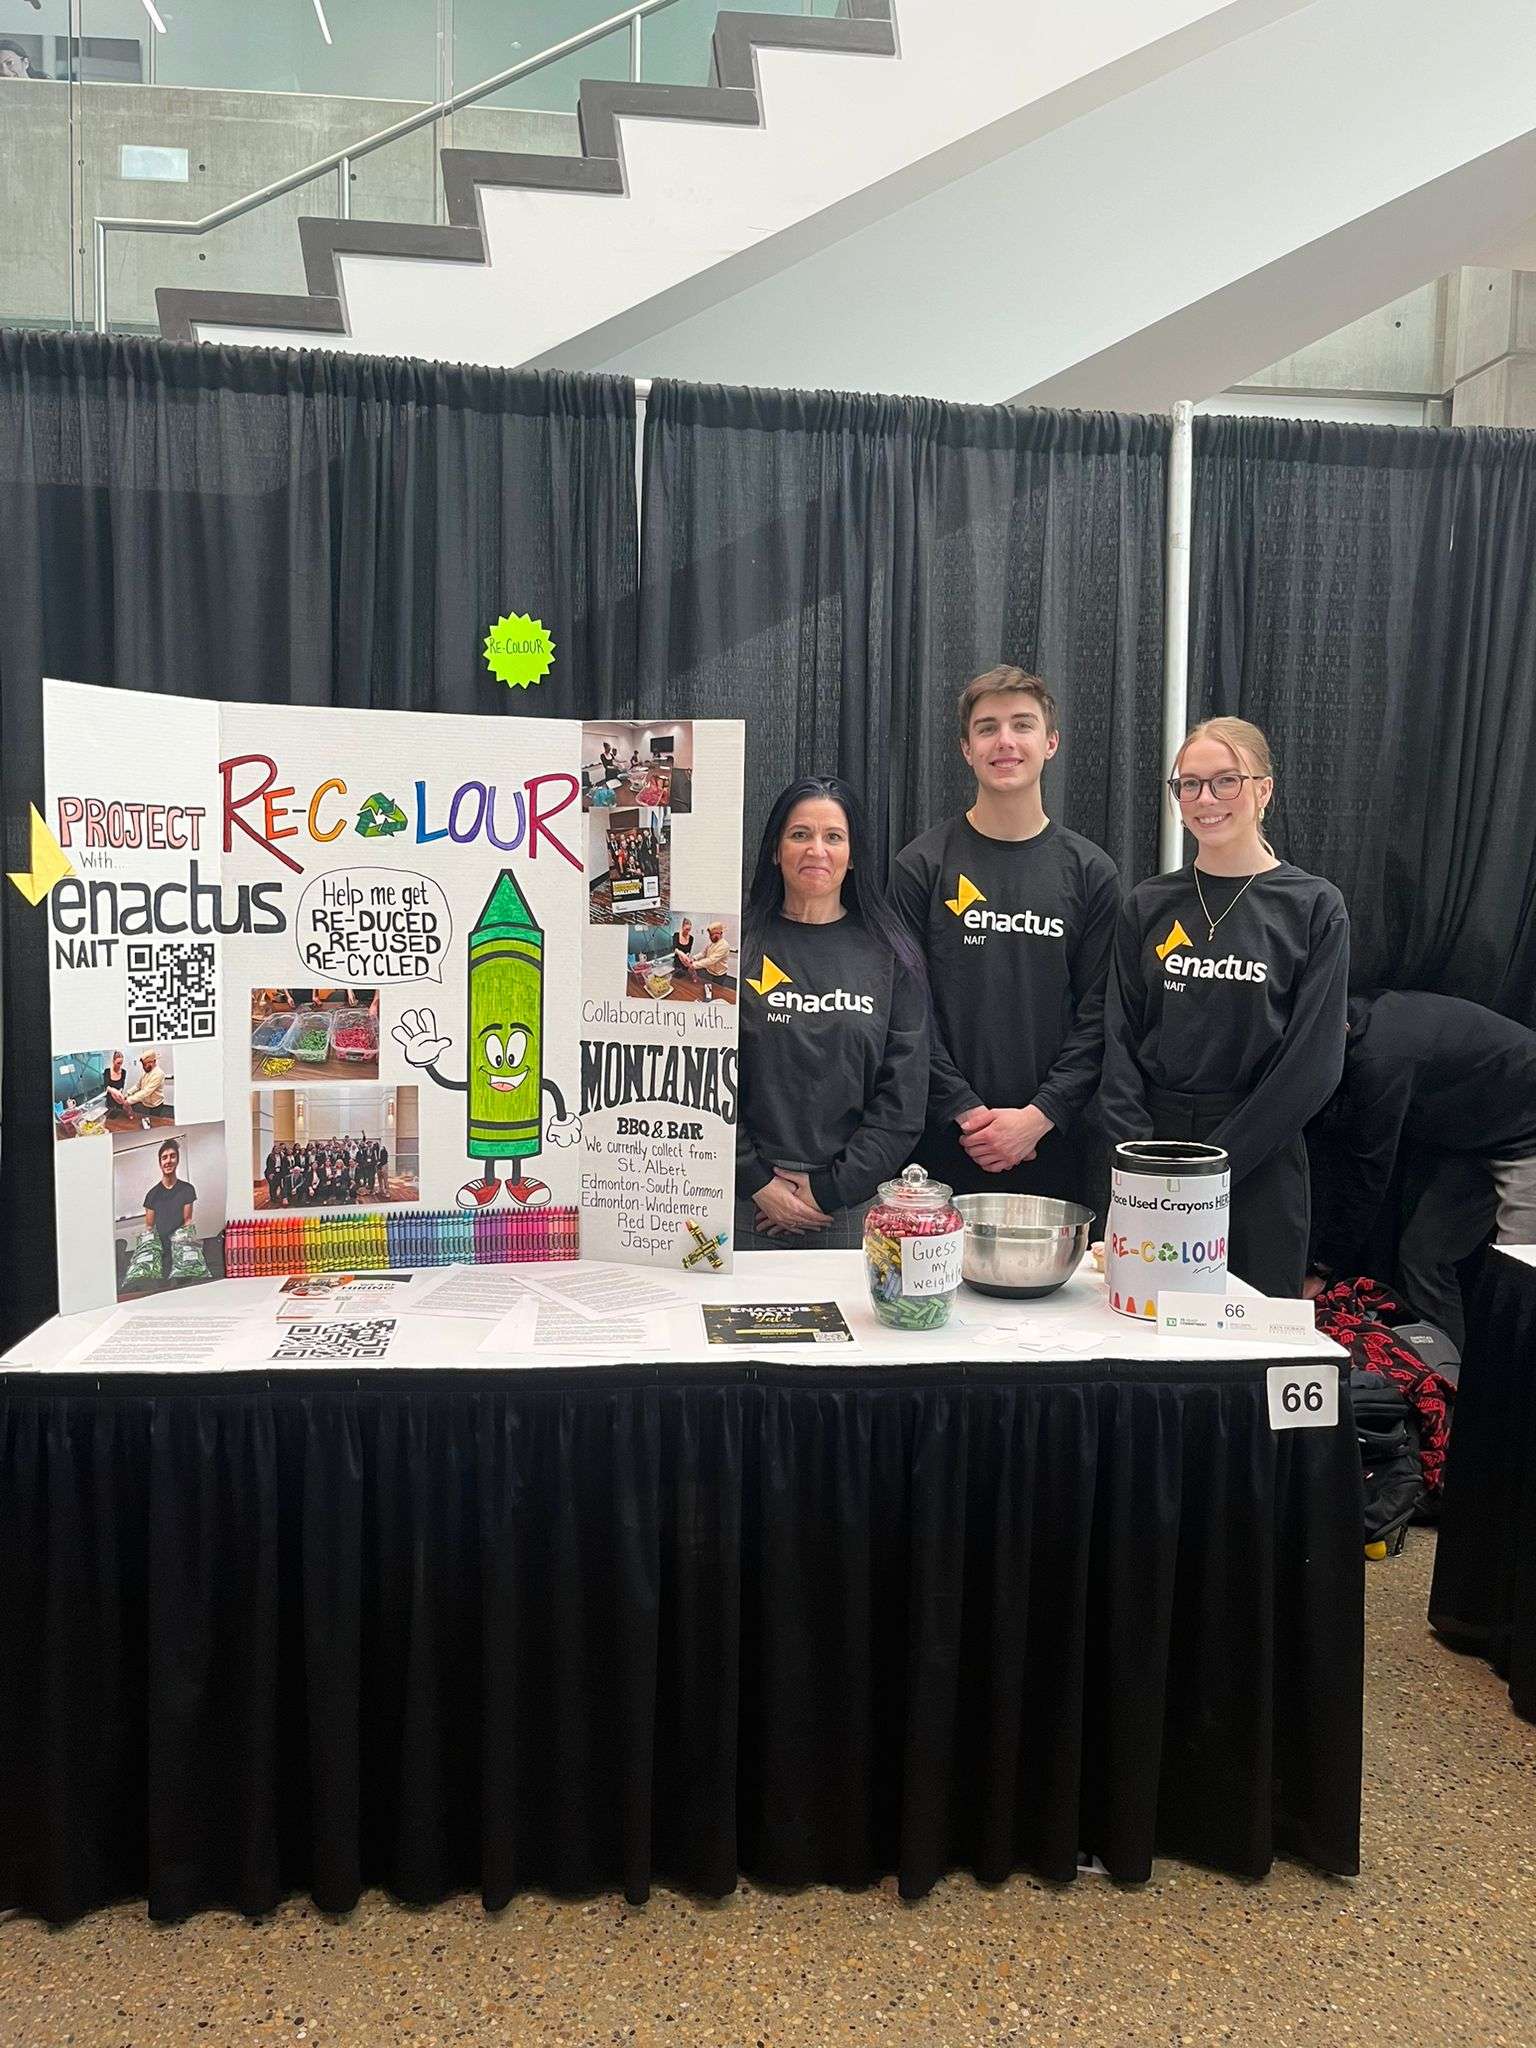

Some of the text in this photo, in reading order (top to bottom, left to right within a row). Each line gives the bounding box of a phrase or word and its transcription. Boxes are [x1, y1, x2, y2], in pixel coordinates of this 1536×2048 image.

[57, 796, 206, 851] PROJECT
[51, 859, 288, 936] enactus
[322, 876, 429, 915] Help me get
[312, 909, 438, 934] RE-DUCED
[964, 908, 1065, 938] enactus
[329, 931, 442, 954] RE-USED
[963, 935, 987, 945] NAIT
[55, 938, 120, 970] NAIT
[306, 942, 430, 977] RE-CYCLED
[1164, 953, 1268, 983] enactus
[1163, 980, 1187, 993] NAIT
[767, 988, 875, 1015] enactus
[582, 999, 686, 1037] Collaborating
[767, 1013, 792, 1024] NAIT
[578, 1039, 738, 1125] MONTANA'S
[585, 1136, 718, 1160] We currently collect from:
[617, 1158, 688, 1177] St. Albert
[683, 1180, 724, 1199] Common
[1112, 1190, 1230, 1214] ace Used Crayons HER
[617, 1212, 682, 1233] Red Deer
[620, 1230, 674, 1256] Jasper
[912, 1240, 957, 1261] Guess
[931, 1260, 948, 1273] my
[1224, 1303, 1245, 1319] 66
[1282, 1381, 1323, 1412] 66
